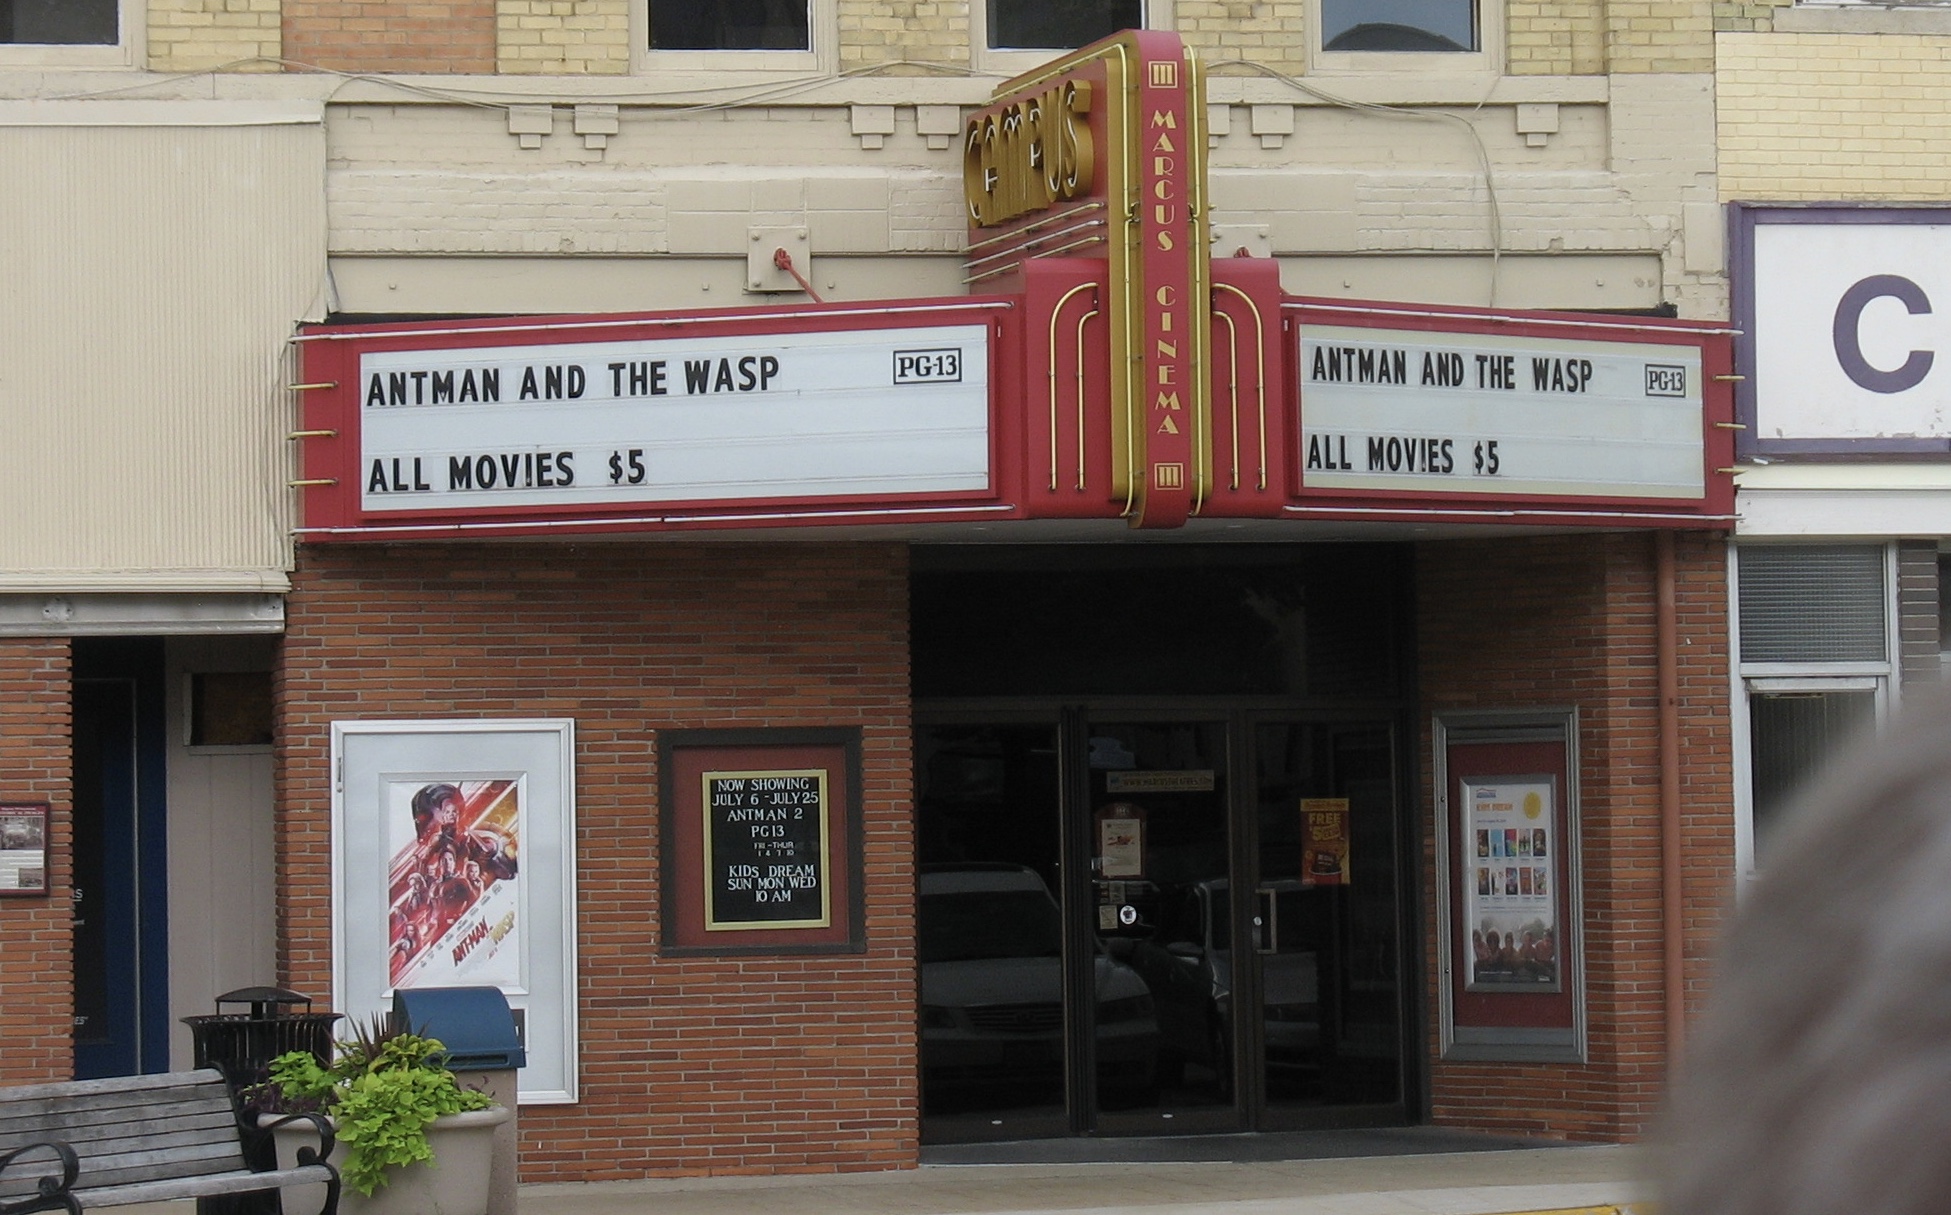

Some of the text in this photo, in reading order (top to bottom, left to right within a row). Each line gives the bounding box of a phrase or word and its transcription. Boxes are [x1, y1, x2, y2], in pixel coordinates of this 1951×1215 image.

[1151, 110, 1181, 434] MARCUS CINEMA
[1833, 274, 1935, 394] C
[1312, 345, 1683, 392] ANTMAN AND THE WASP PG-13
[366, 354, 958, 407] ANTMAN AND THE WASP PG-13
[1307, 434, 1352, 470] ALL
[1474, 441, 1500, 475] $5
[368, 457, 430, 492] ALL
[608, 449, 646, 485] $5
[717, 777, 809, 791] NOW SHOWING
[712, 793, 743, 806] JULY
[750, 793, 759, 805] 6
[802, 791, 819, 804] 25
[727, 807, 803, 822] ANTMAN 2
[1308, 812, 1341, 825] FREE
[729, 864, 815, 878] KIDS DREAM
[727, 876, 817, 891] SUN MON WED
[755, 890, 791, 902] 10 AM
